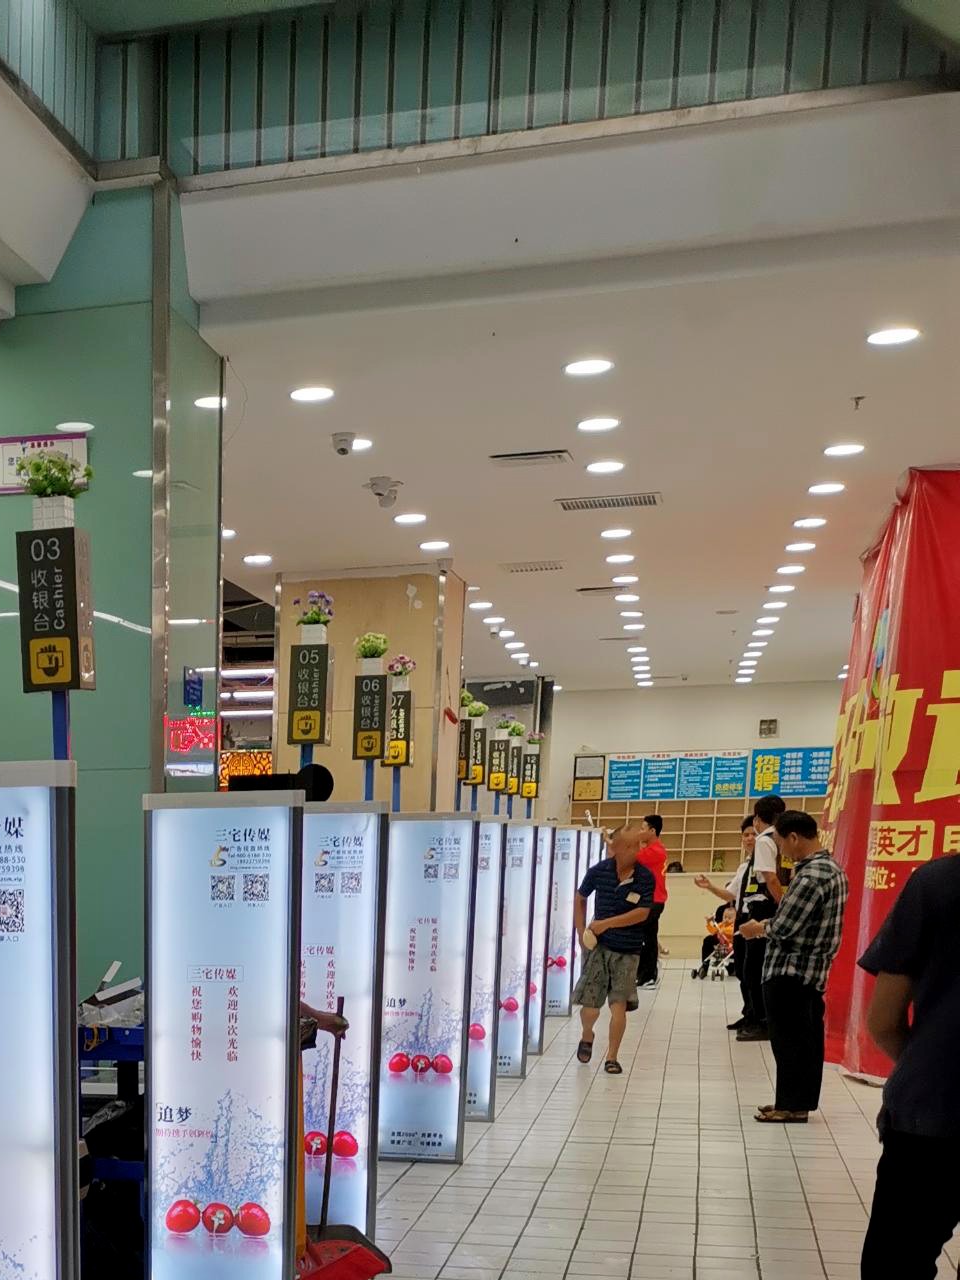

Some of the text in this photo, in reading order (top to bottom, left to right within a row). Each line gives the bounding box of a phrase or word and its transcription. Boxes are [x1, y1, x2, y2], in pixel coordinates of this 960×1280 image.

[30, 537, 61, 562] 03
[31, 568, 50, 632] 收银台
[52, 566, 65, 630] Cashier
[300, 650, 319, 664] 05
[297, 668, 310, 707] 收银台
[310, 668, 320, 707] Cashier
[362, 679, 380, 692] 06
[215, 827, 270, 842] 三宅传媒
[191, 968, 237, 980] 三宅传媒
[326, 959, 335, 1010] 欢迎再次光
[191, 985, 202, 1062] 祝您购物愉快
[227, 985, 238, 1062] 欢迎再次光临
[157, 1106, 192, 1123] 追梦
